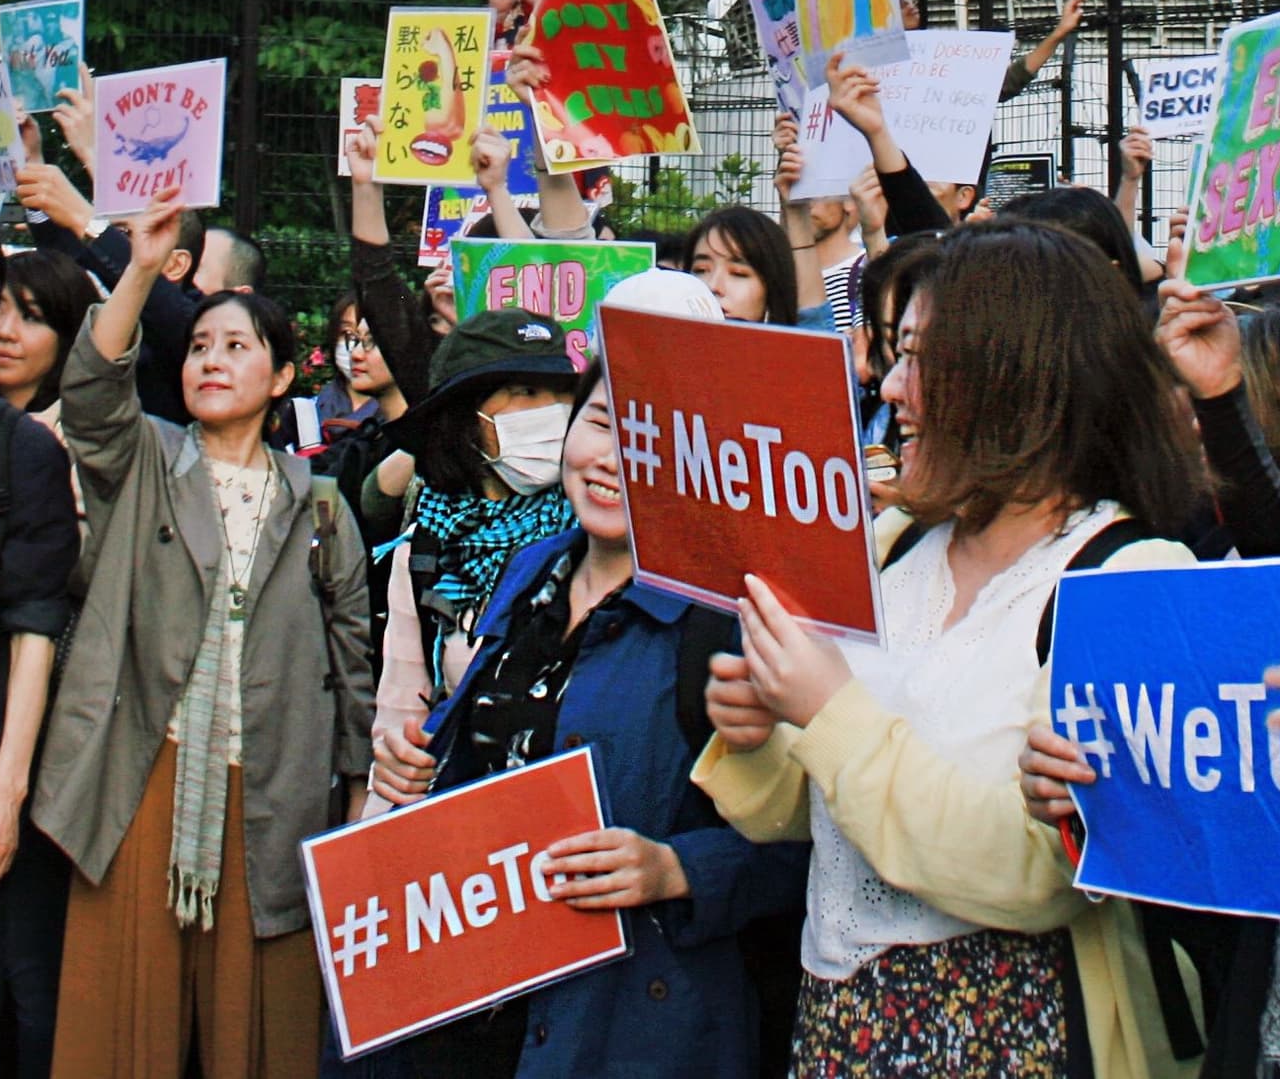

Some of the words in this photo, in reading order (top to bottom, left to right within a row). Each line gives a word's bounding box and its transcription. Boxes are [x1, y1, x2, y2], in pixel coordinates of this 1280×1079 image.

[542, 2, 631, 39] BODY
[453, 25, 480, 92] 私は
[572, 42, 627, 72] MY
[1149, 66, 1218, 94] FUCK
[104, 113, 117, 131] I
[115, 82, 177, 117] WON'T
[180, 87, 209, 121] BE
[387, 26, 420, 165] 黙らない
[489, 261, 587, 318] END
[621, 398, 859, 532] #MeToo
[333, 842, 560, 977] #MeTo
